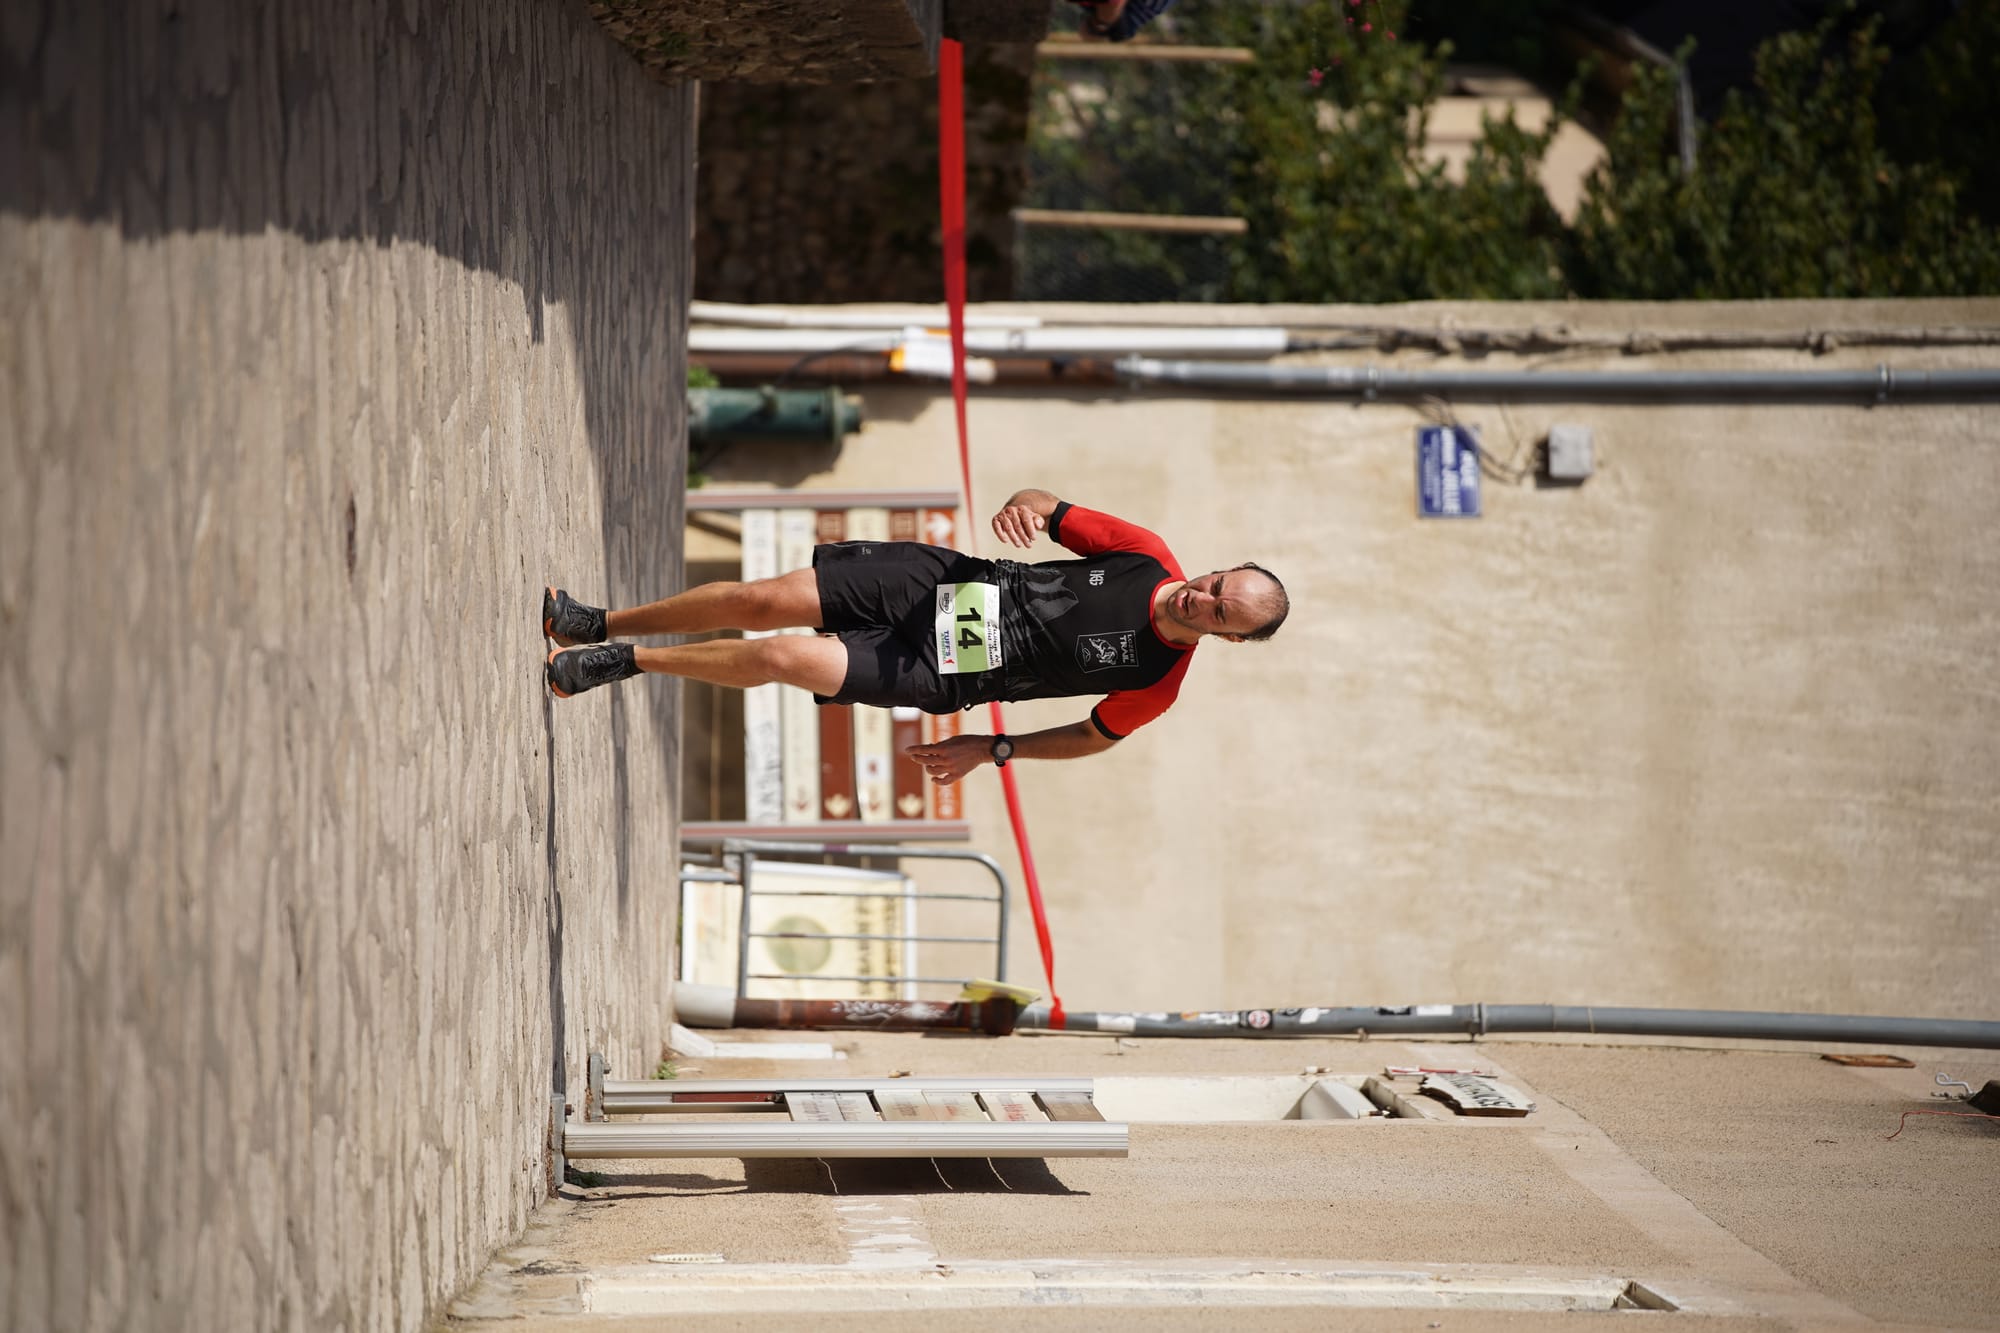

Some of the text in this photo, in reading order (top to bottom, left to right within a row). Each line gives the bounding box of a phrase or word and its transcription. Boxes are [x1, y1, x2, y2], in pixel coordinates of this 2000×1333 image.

[1460, 450, 1476, 487] RUE
[957, 607, 982, 649] 14
[1120, 634, 1128, 664] TRAIL
